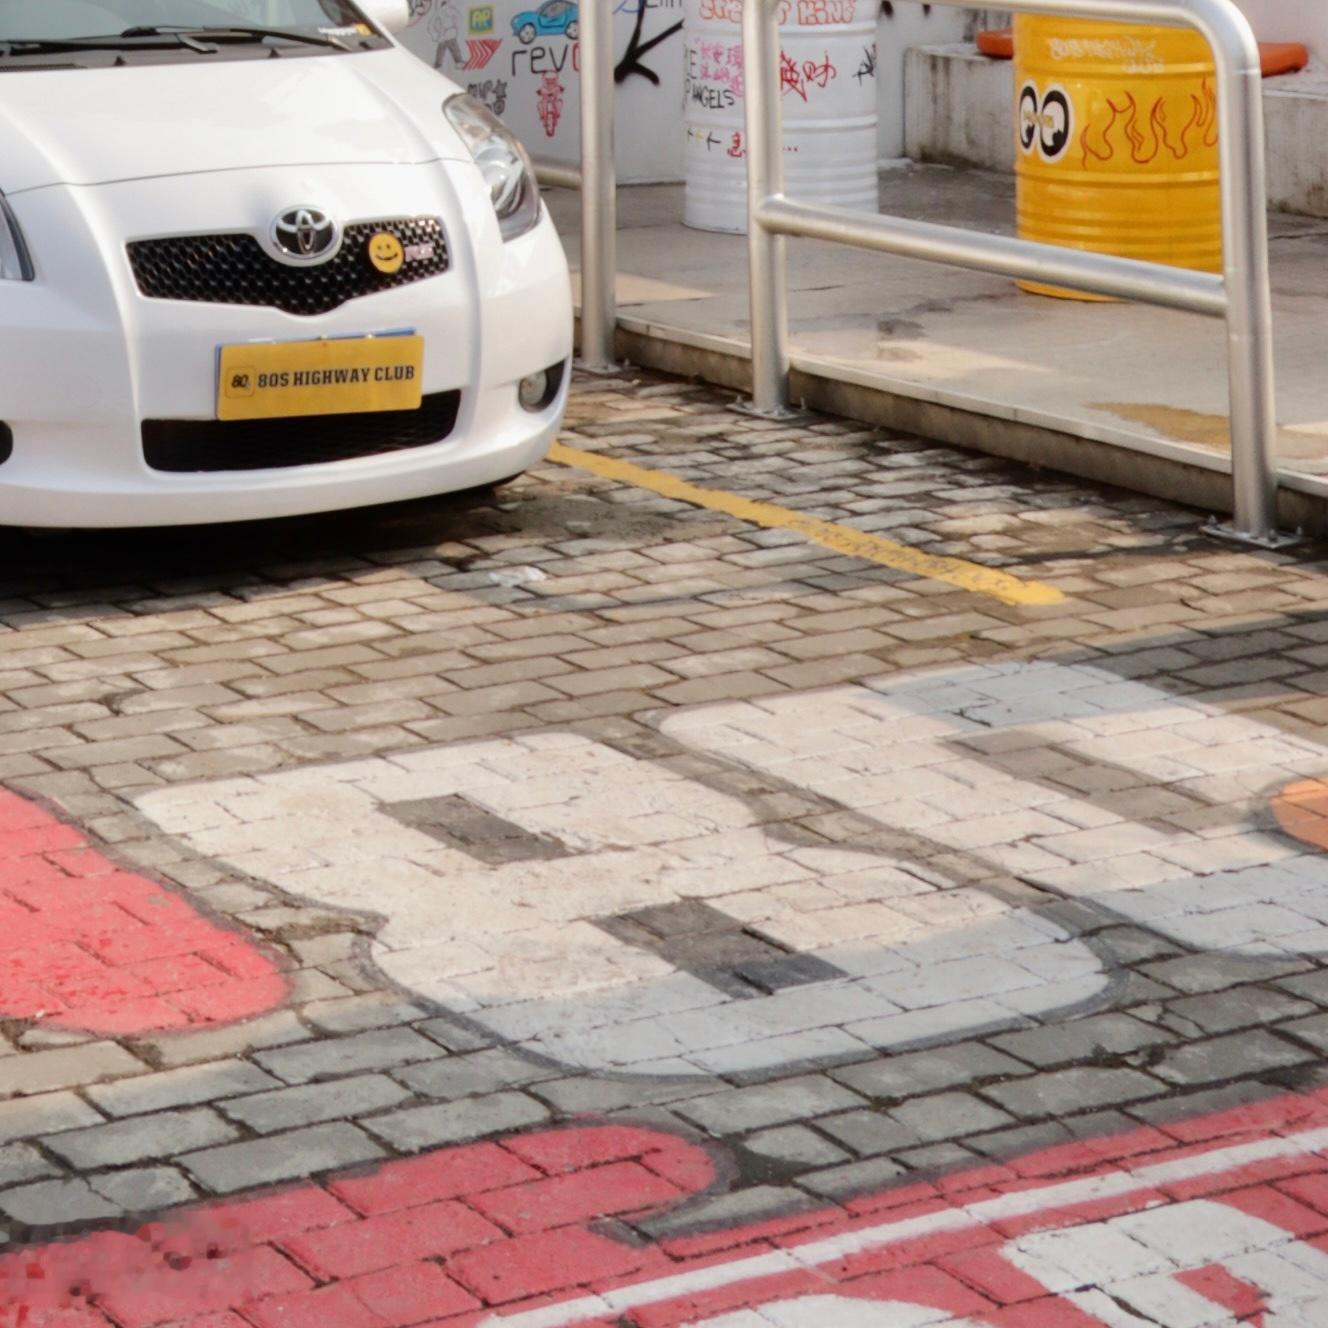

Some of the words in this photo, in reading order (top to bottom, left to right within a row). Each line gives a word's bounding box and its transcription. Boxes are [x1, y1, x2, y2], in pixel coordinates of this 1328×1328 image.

[257, 372, 290, 388] 80S
[293, 366, 371, 387] HIGHWAY
[374, 364, 417, 382] CLUB
